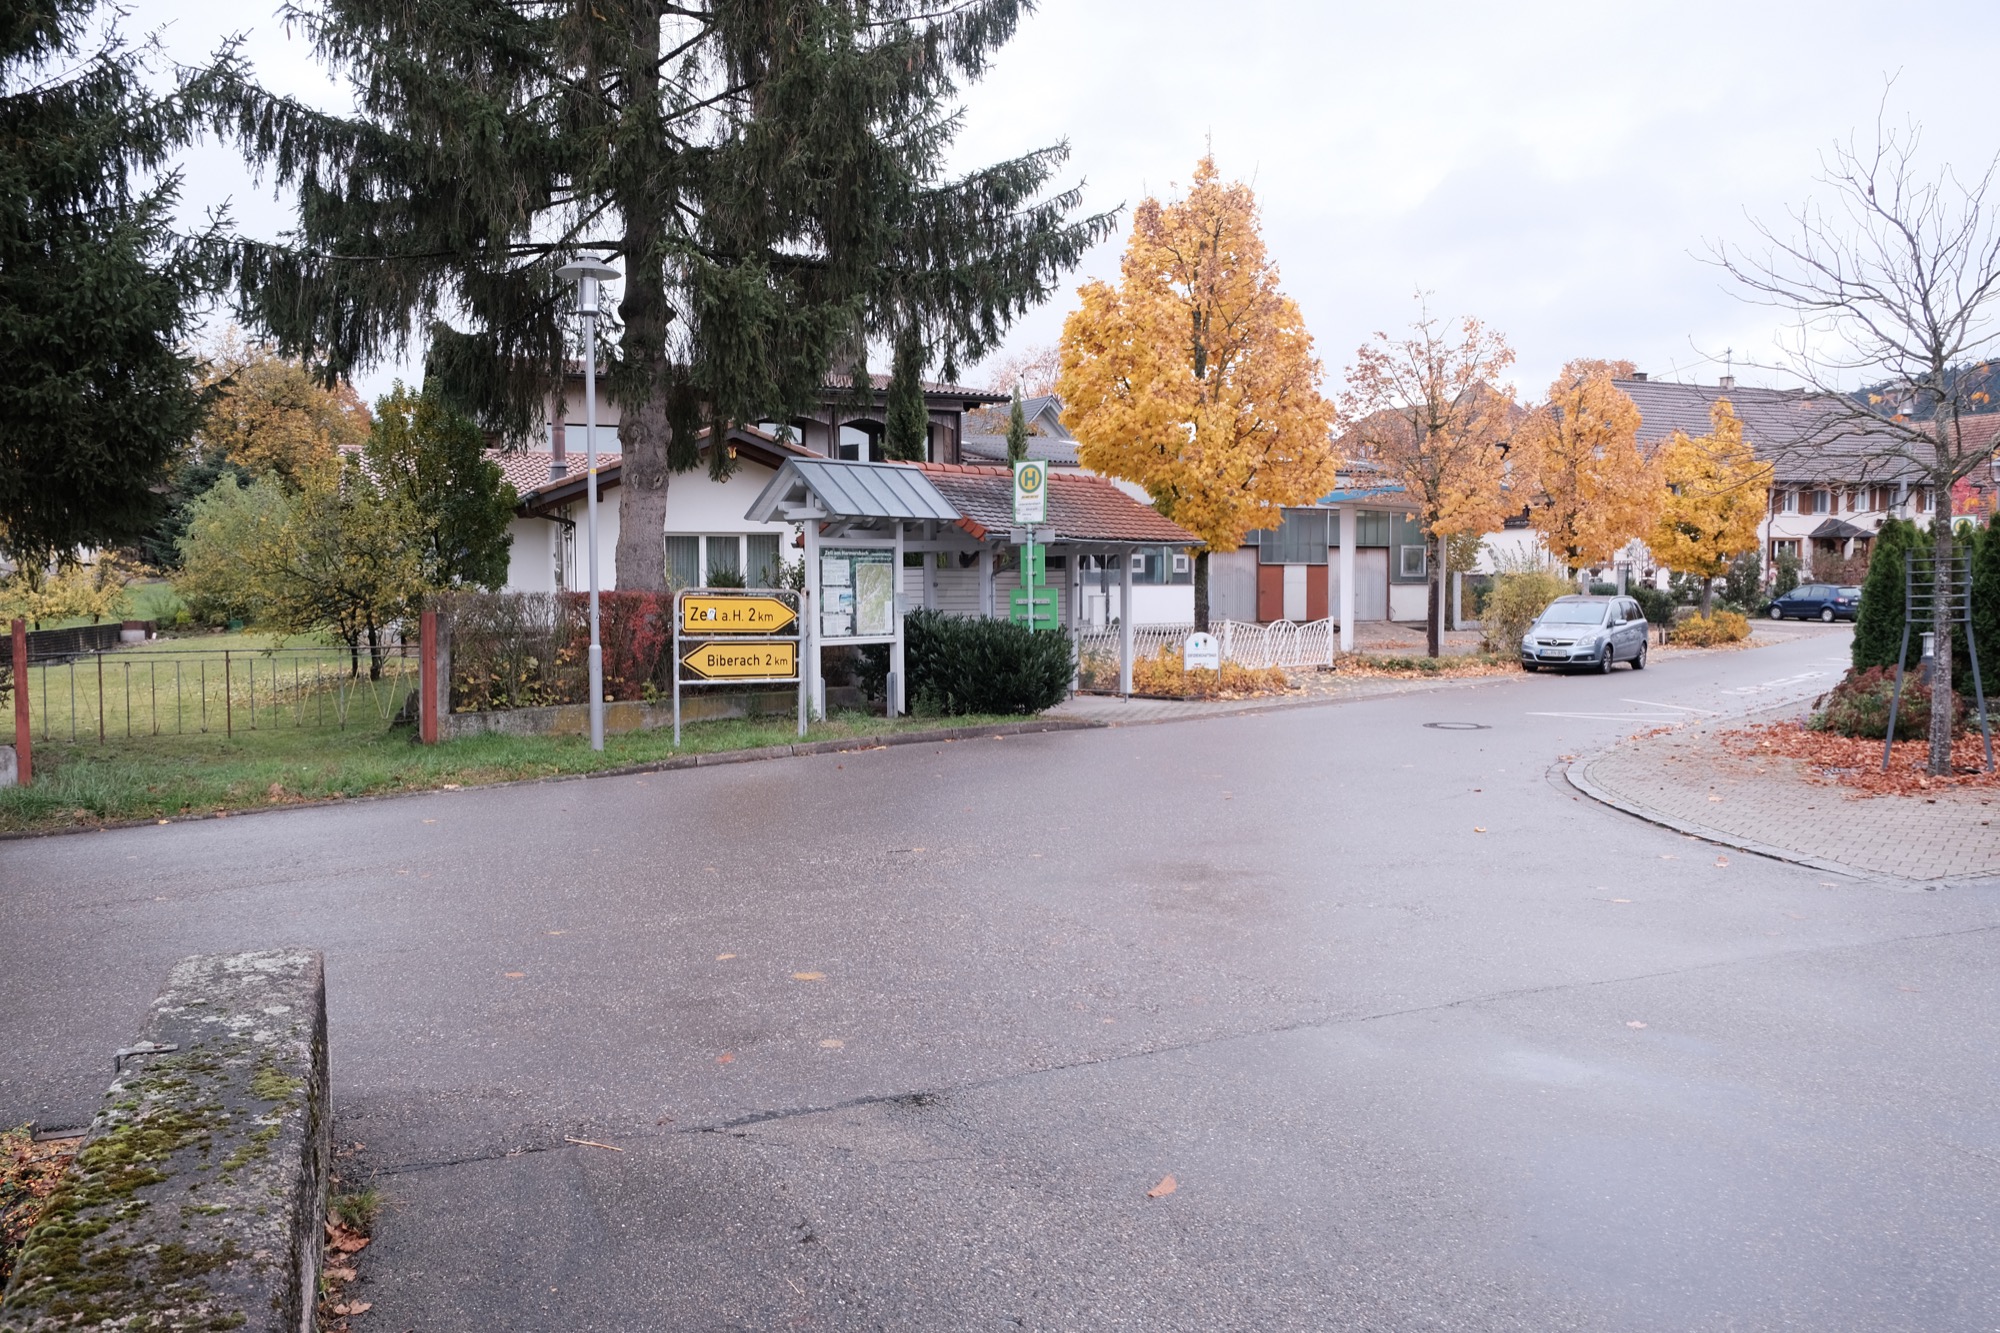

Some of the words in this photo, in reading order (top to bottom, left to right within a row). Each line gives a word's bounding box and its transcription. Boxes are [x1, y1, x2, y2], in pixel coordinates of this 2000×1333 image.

[1024, 472, 1036, 486] H
[690, 606, 717, 621] Zel
[748, 607, 756, 622] 2
[758, 612, 774, 622] km
[707, 654, 760, 667] Biberach
[765, 653, 772, 666] 2
[774, 657, 788, 666] km
